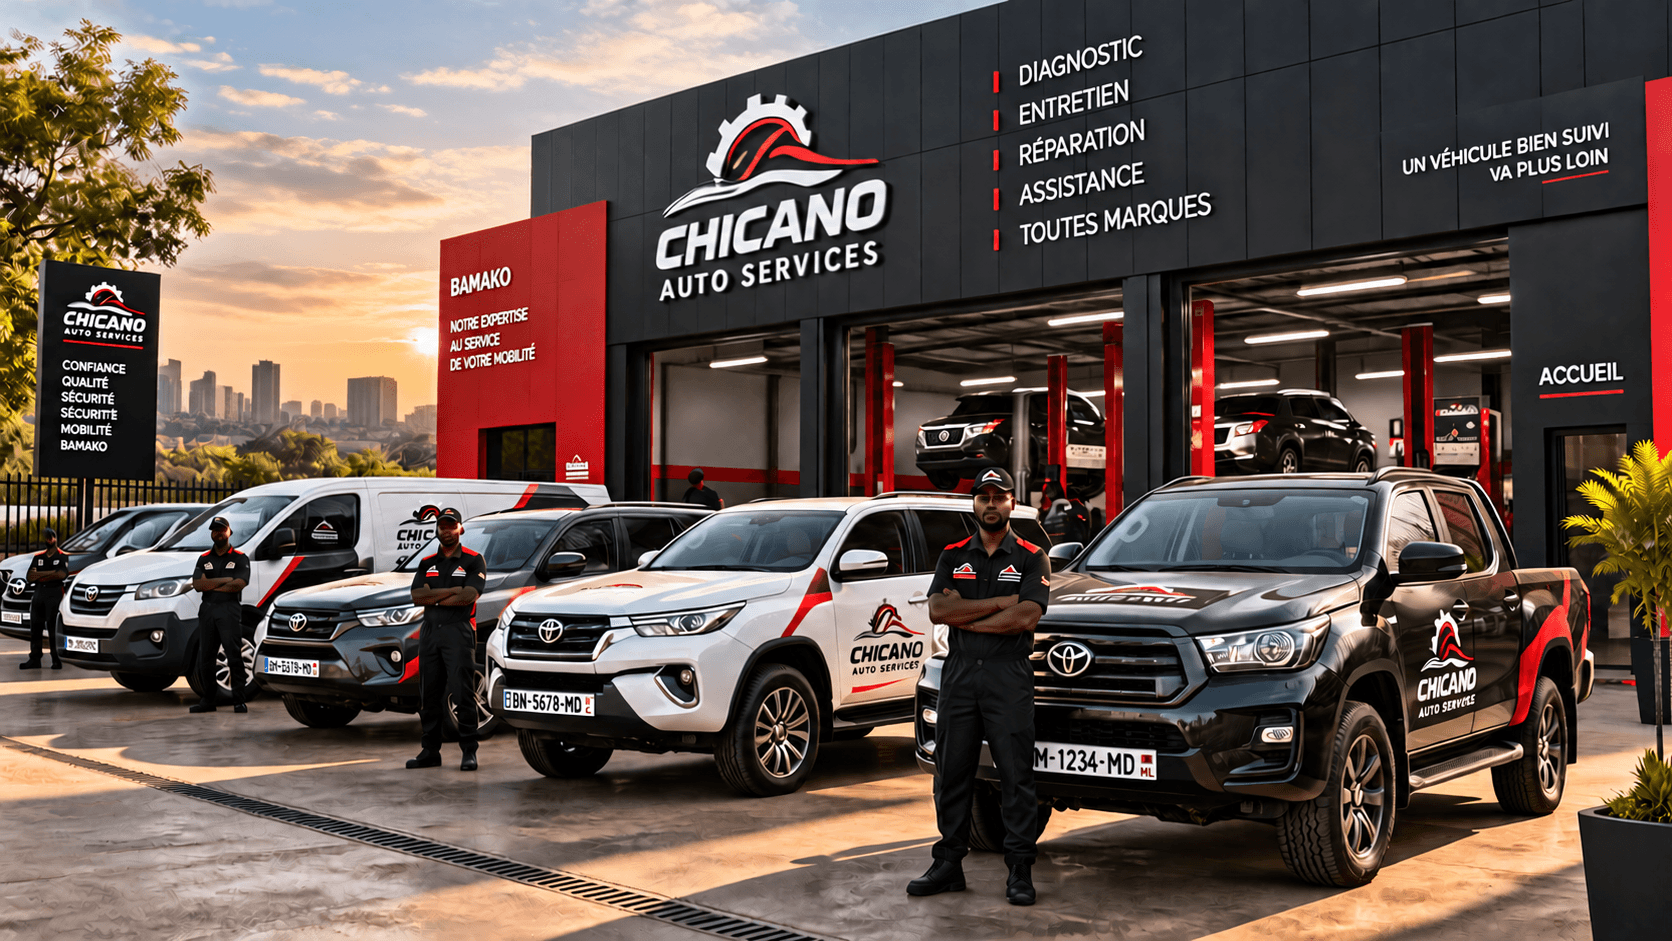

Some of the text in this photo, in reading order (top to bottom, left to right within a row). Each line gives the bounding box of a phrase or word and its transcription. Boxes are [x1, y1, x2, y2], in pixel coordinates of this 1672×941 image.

[1019, 35, 1144, 87] DIAGNOSTIC
[1019, 78, 1130, 126] ENTRETIEN
[1019, 118, 1146, 167] RÉPARATION
[1402, 121, 1610, 176] UN VÉHICULE BIEN SUIVI
[1489, 147, 1609, 182] VA PLUS LOIN
[1018, 161, 1145, 207] ASSISTANCE
[655, 178, 888, 271] CHICANO
[1019, 192, 1213, 246] TOUTES MARQUES
[450, 266, 513, 298] BAMAKO
[658, 240, 879, 302] AUTO SERVICES
[63, 310, 147, 333] CHICANO
[450, 306, 530, 334] NOTRE EXPERTISE
[63, 327, 144, 343] AUTO SERVICES
[450, 332, 501, 352] AU SERVICE
[61, 359, 127, 375] CONFIANCE
[450, 342, 537, 372] DE VOTRE MOBILITÉ
[61, 375, 110, 389] QUALITÉ
[1538, 362, 1625, 386] ACCUEIL
[60, 389, 116, 406] SÉCURITÉ
[60, 422, 113, 437] MOBILITÉ
[60, 439, 109, 453] BAMAKO
[396, 529, 435, 542] CHIC
[396, 542, 421, 551] AUTO
[850, 640, 924, 665] CHICANO
[852, 665, 877, 676] AUTO
[1417, 666, 1477, 702] CHICANO
[512, 691, 582, 713] BN-5678-MD
[1418, 703, 1440, 719] AUTO
[1034, 747, 1135, 776] M-1234-MD
[1140, 767, 1155, 778] ML
